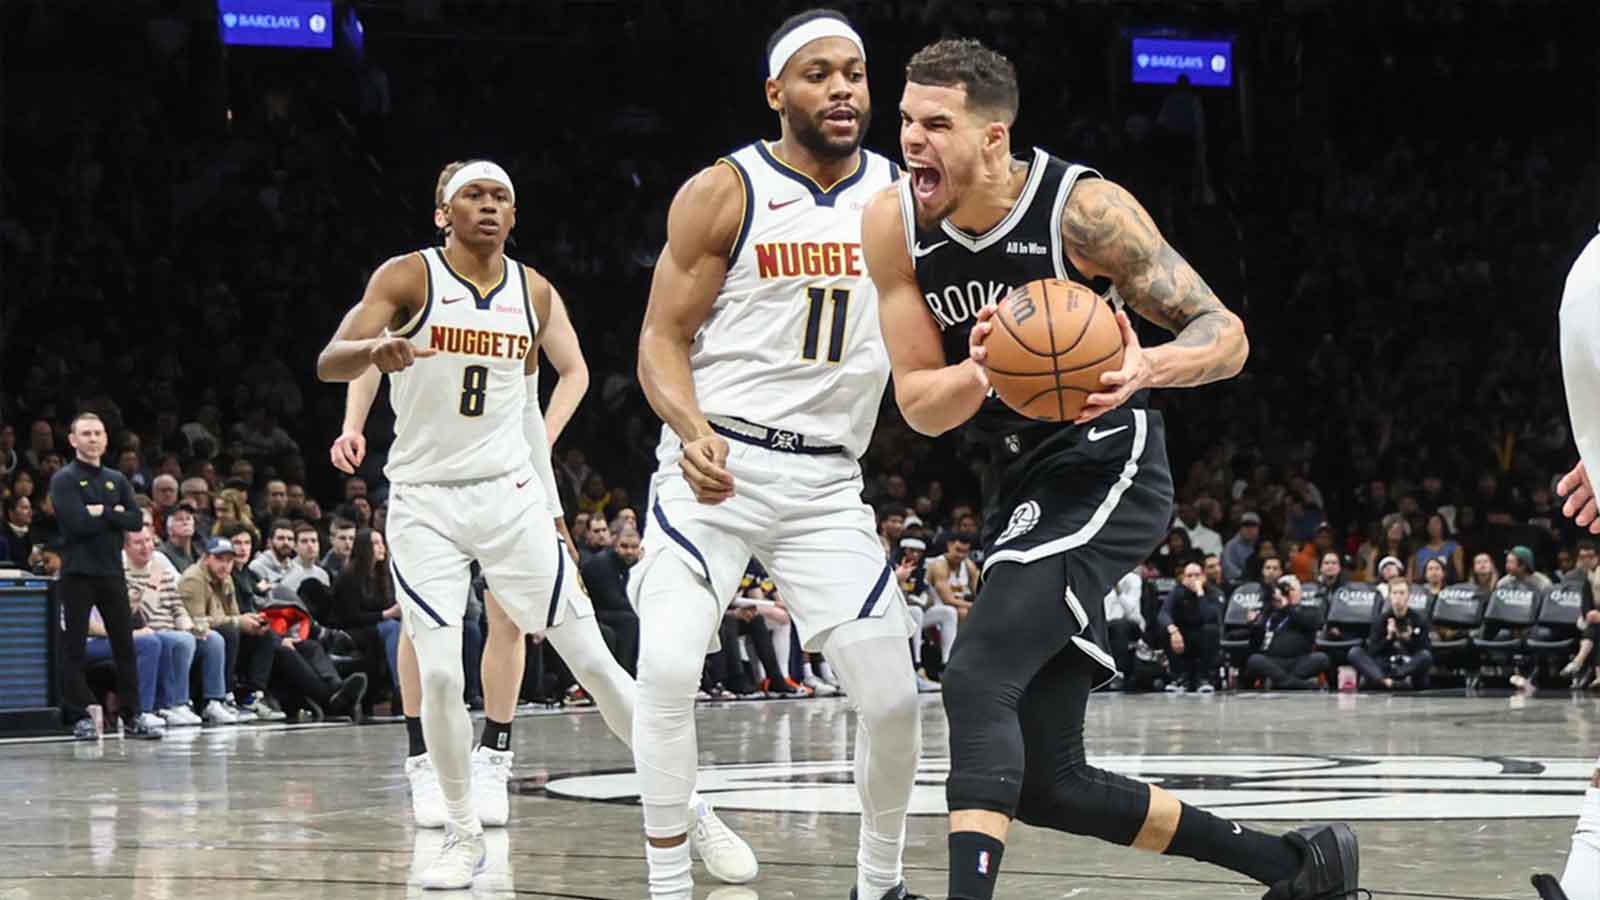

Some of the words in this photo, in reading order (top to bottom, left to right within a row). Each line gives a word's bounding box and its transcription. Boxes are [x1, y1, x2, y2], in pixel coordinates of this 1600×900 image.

[239, 14, 300, 28] BARCLAYS
[754, 242, 862, 279] NUGGE
[1006, 241, 1018, 254] All
[801, 285, 850, 363] 11
[925, 281, 1010, 331] ROOK
[430, 326, 529, 360] NUGGETS
[459, 364, 488, 417] 8
